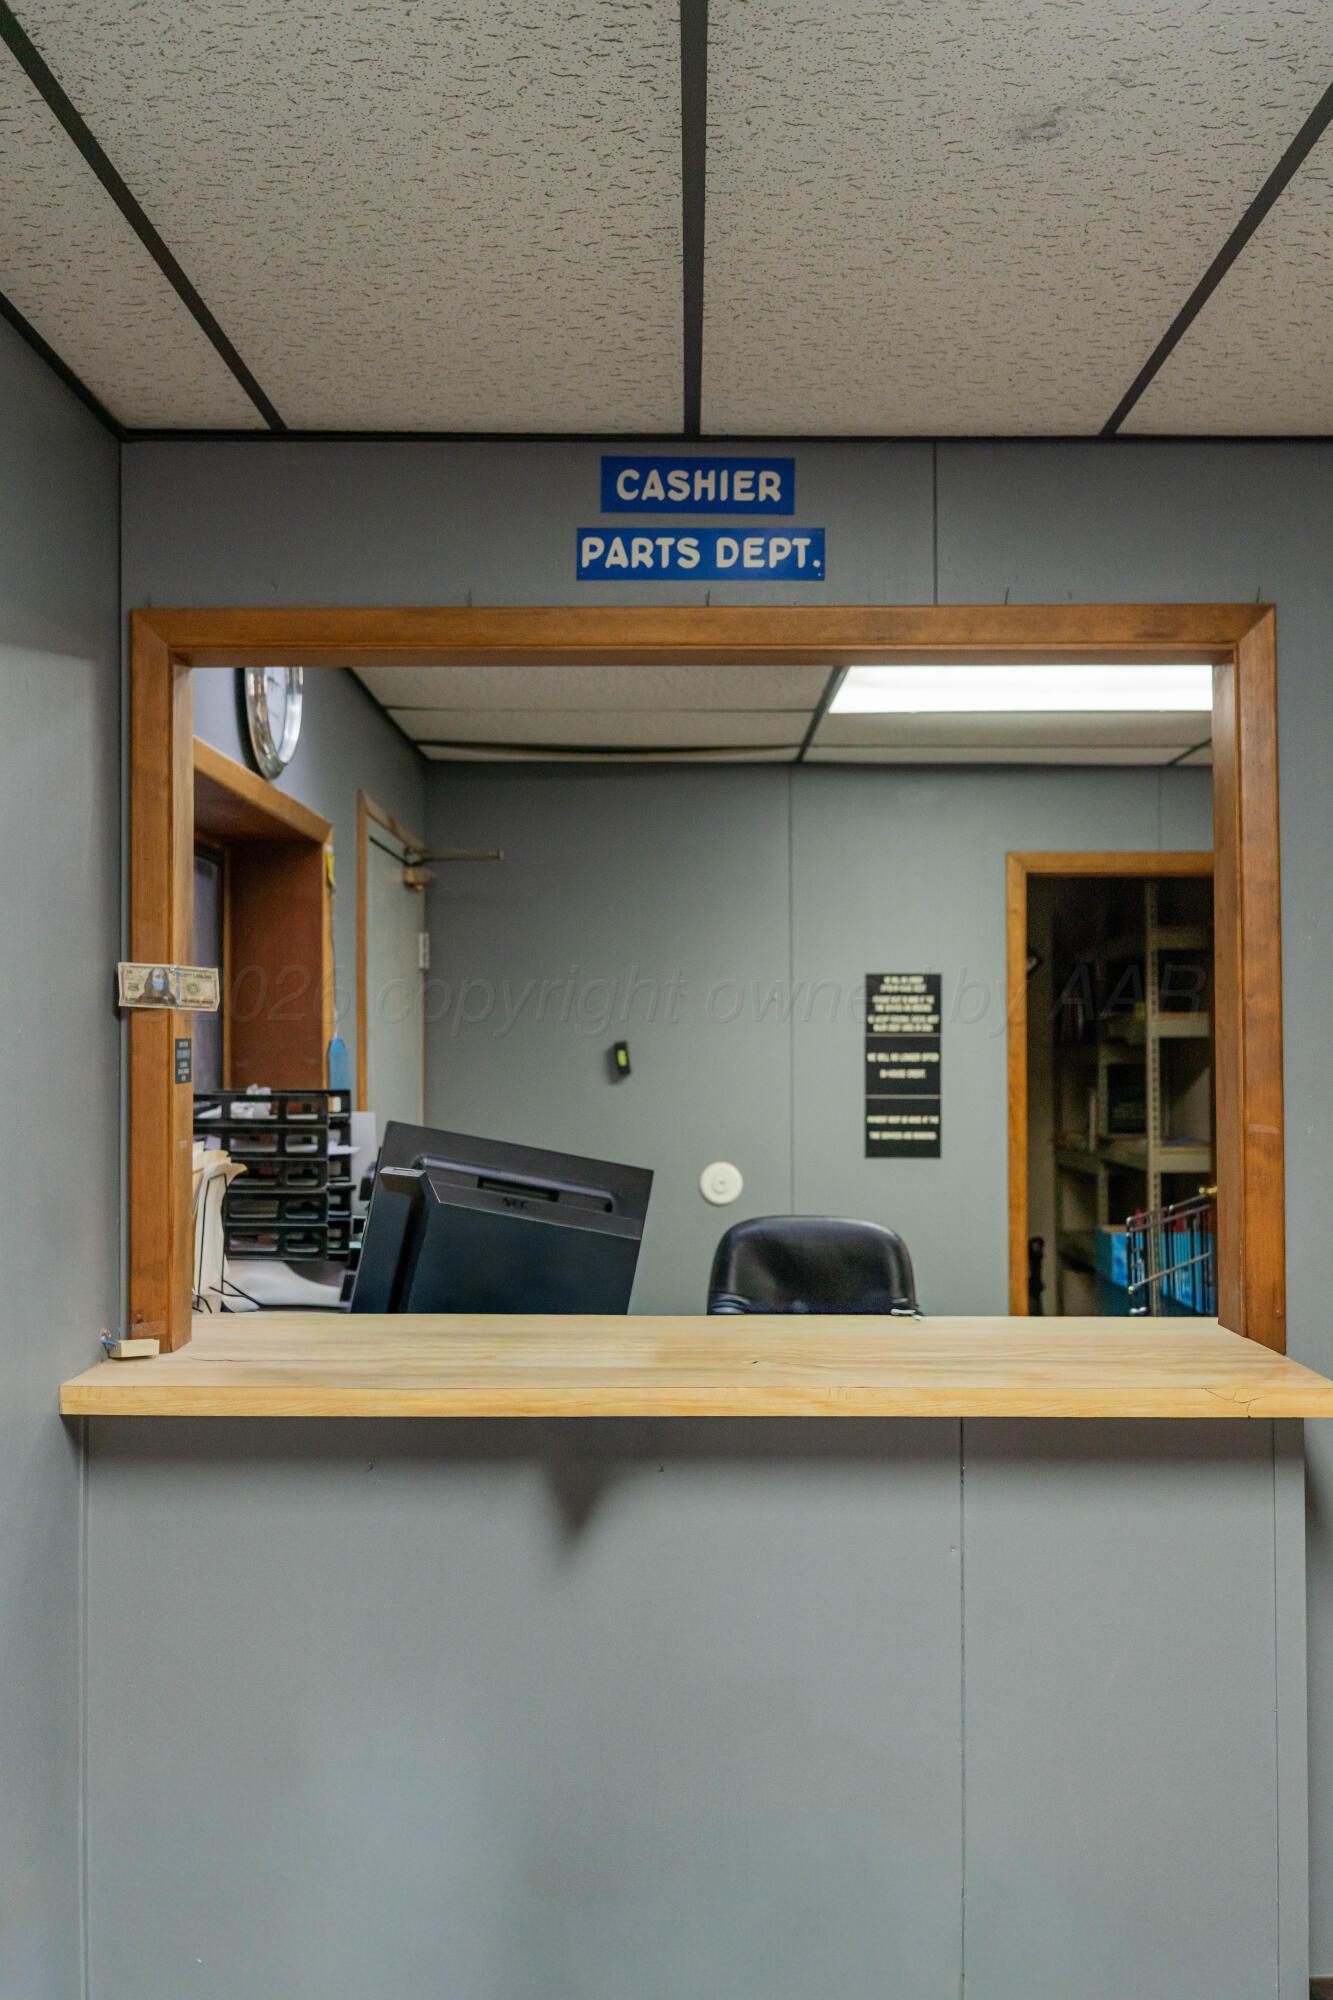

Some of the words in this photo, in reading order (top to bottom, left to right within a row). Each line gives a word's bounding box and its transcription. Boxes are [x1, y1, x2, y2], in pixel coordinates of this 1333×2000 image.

[616, 469, 782, 502] CASHIER
[581, 537, 700, 569] PARTS
[716, 537, 821, 569] DEPT.
